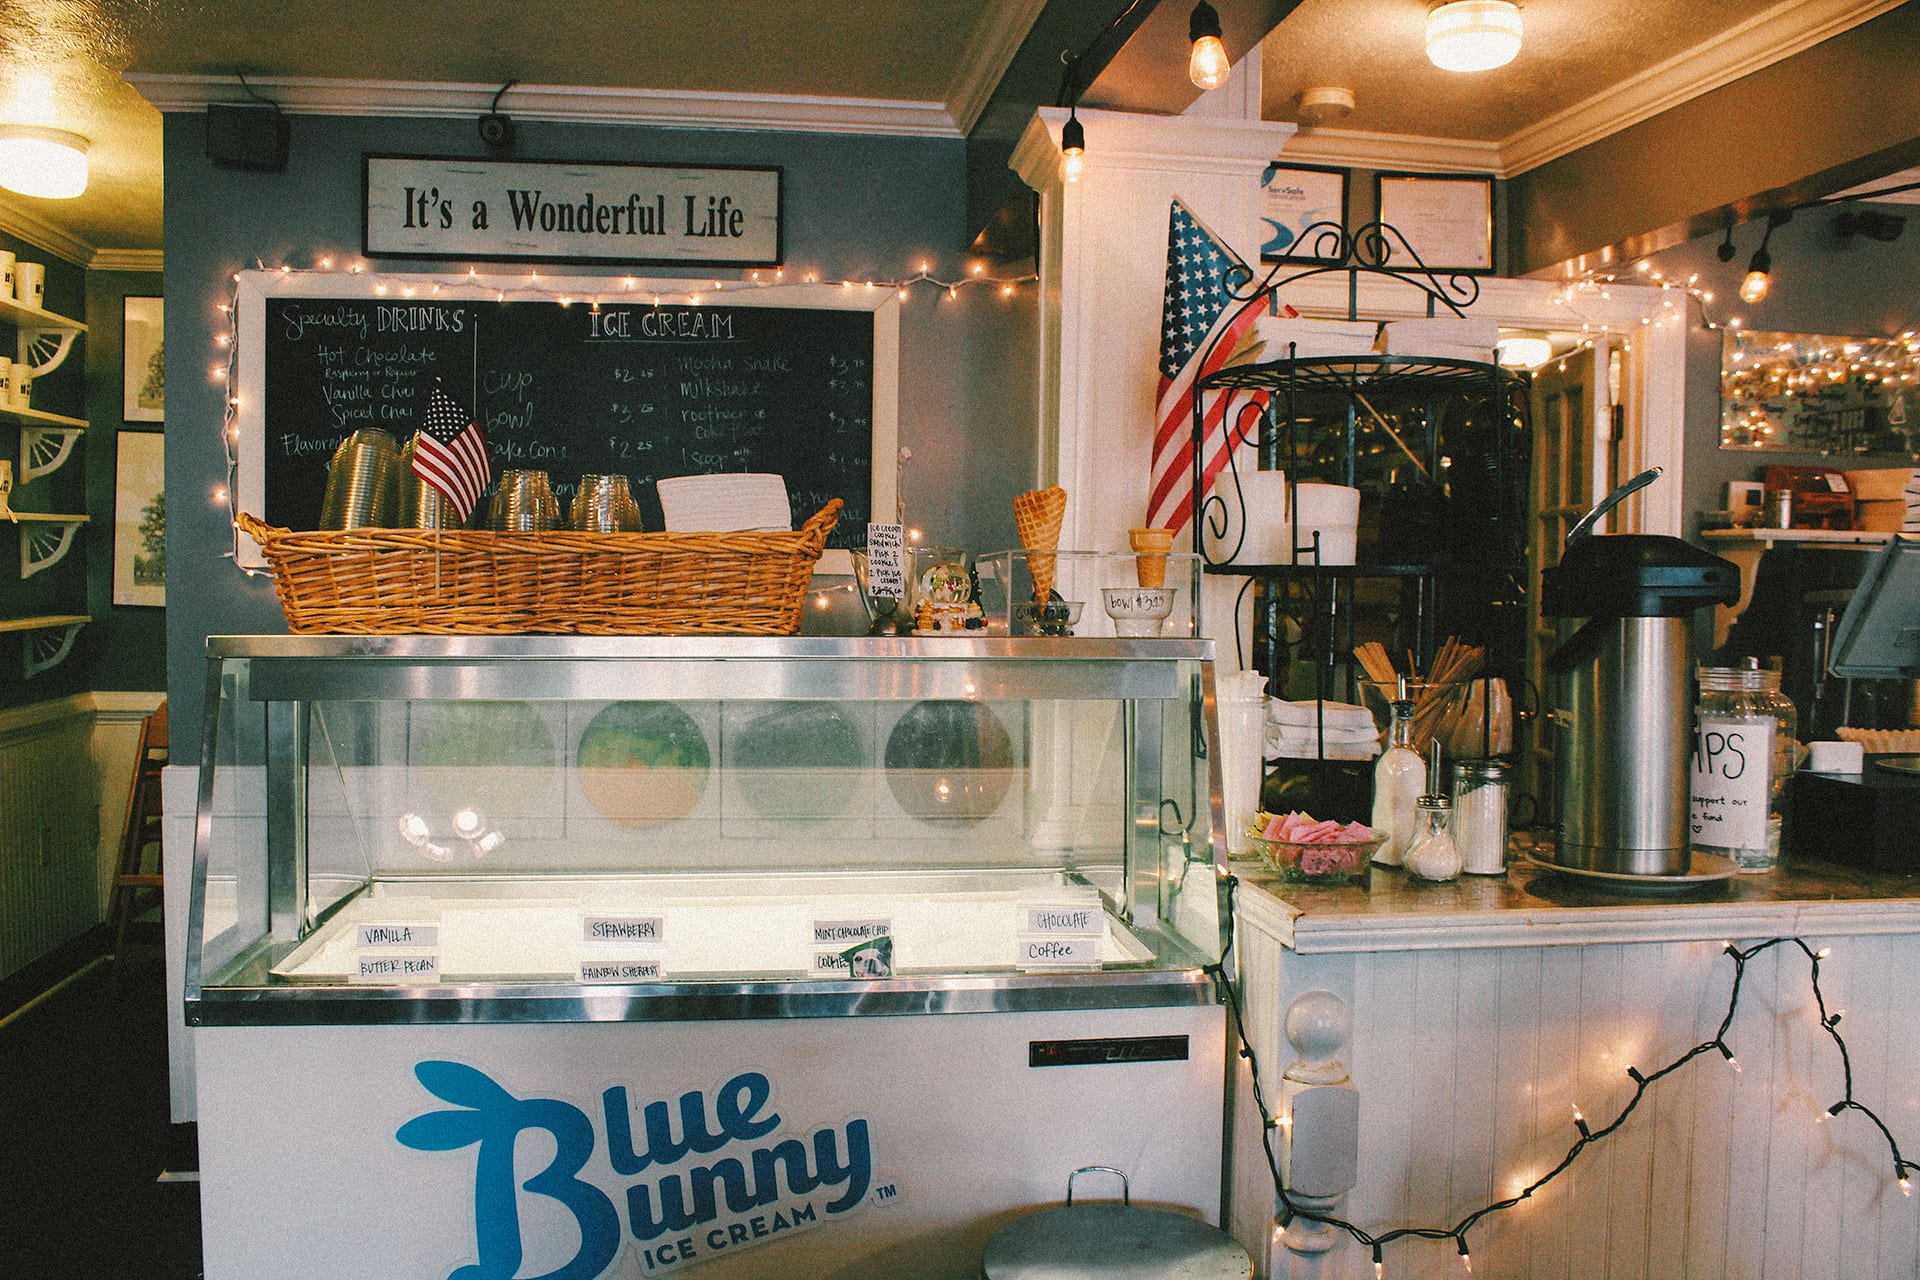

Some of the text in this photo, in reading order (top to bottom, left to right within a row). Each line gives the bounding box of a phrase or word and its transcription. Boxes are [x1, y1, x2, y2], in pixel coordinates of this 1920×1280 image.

[403, 186, 744, 238] It's a Wonderful Life
[281, 304, 465, 341] Specialty DRINKS
[588, 311, 736, 339] ICE CREAM
[318, 343, 437, 367] Hot Chocolate
[322, 384, 373, 405] Vanilla
[331, 403, 375, 429] Spiced
[364, 927, 414, 944] VANILLA
[592, 920, 656, 938] STRAWBERRY
[815, 927, 836, 940] MINT
[1029, 941, 1073, 959] Coffee
[360, 956, 435, 976] BUTTER PECAN
[582, 966, 620, 980] RAINBOW
[643, 1202, 817, 1270] ICE CREAM
